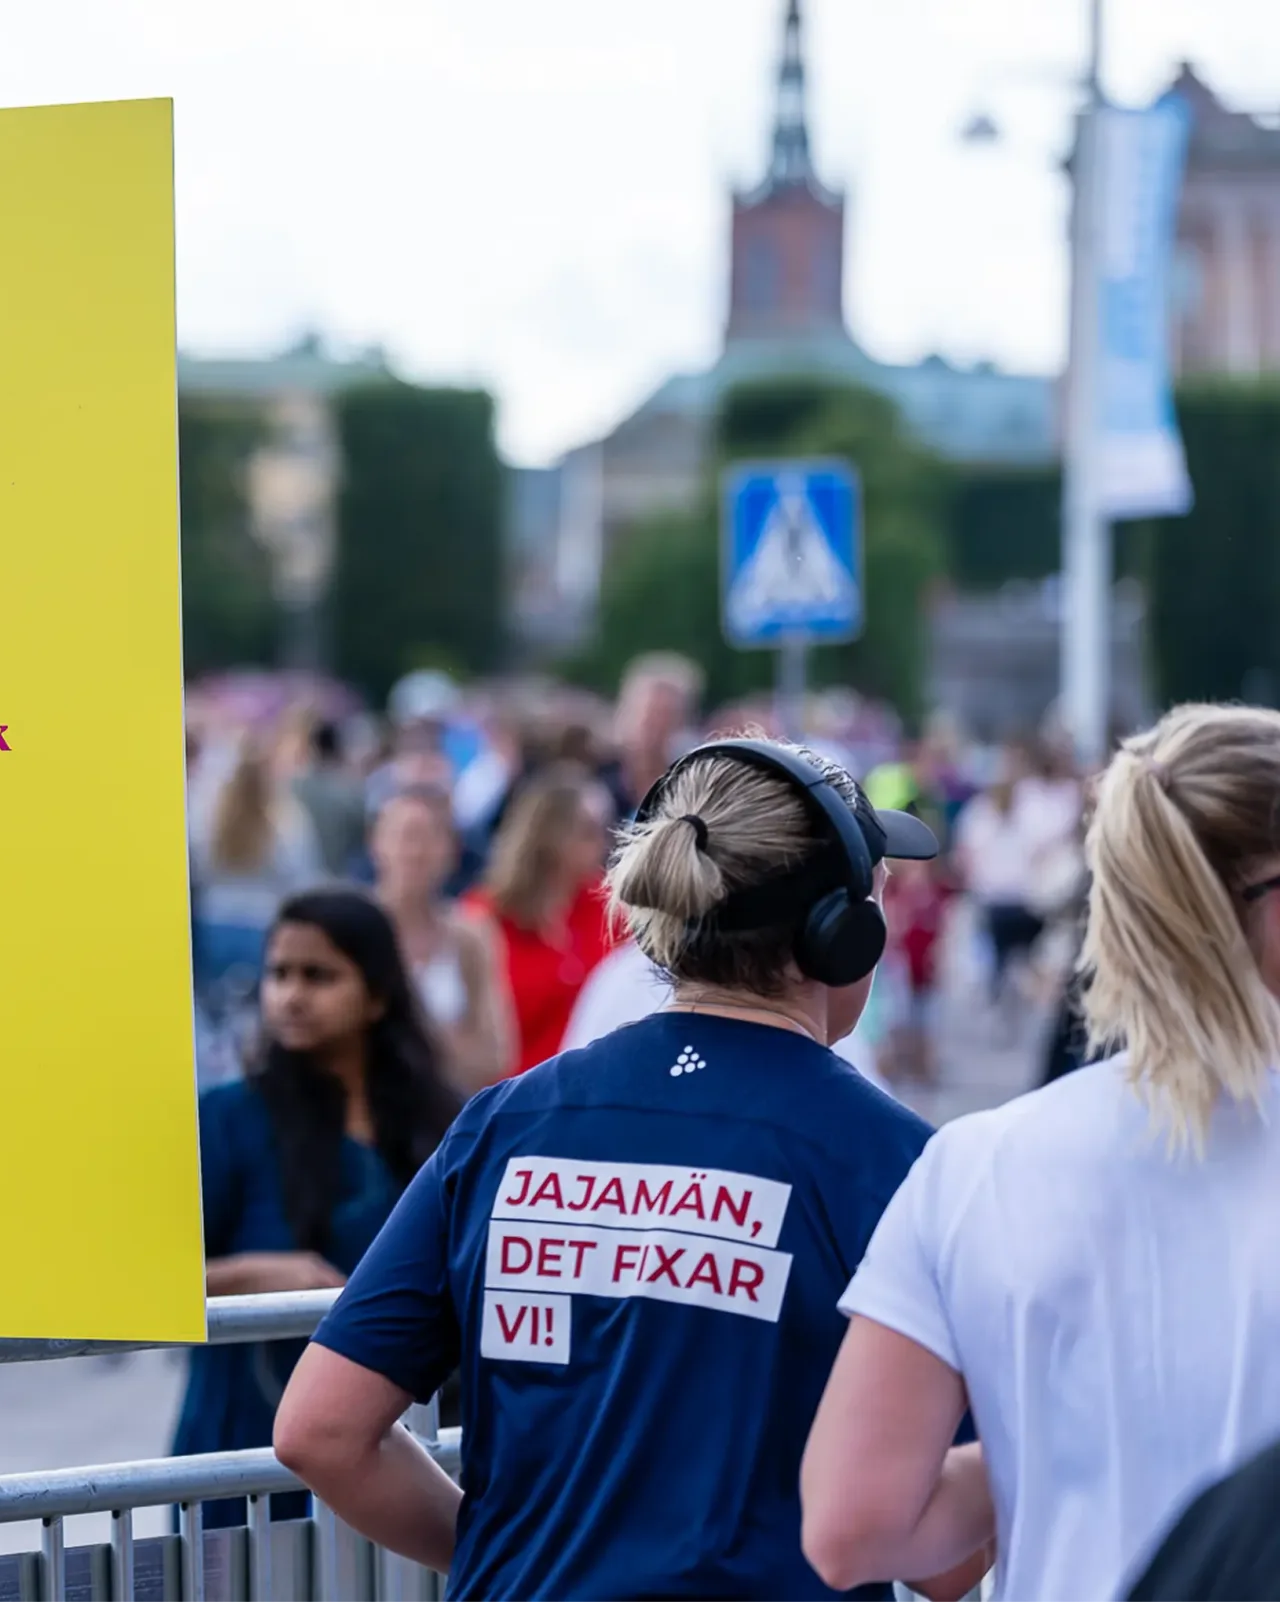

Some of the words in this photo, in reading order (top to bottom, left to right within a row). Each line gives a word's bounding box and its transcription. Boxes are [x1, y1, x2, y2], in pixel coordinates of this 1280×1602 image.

[504, 1169, 764, 1239] JAJAMÄN,
[500, 1235, 597, 1279] DET
[611, 1243, 765, 1303] FIXAR
[495, 1304, 554, 1347] VI!
